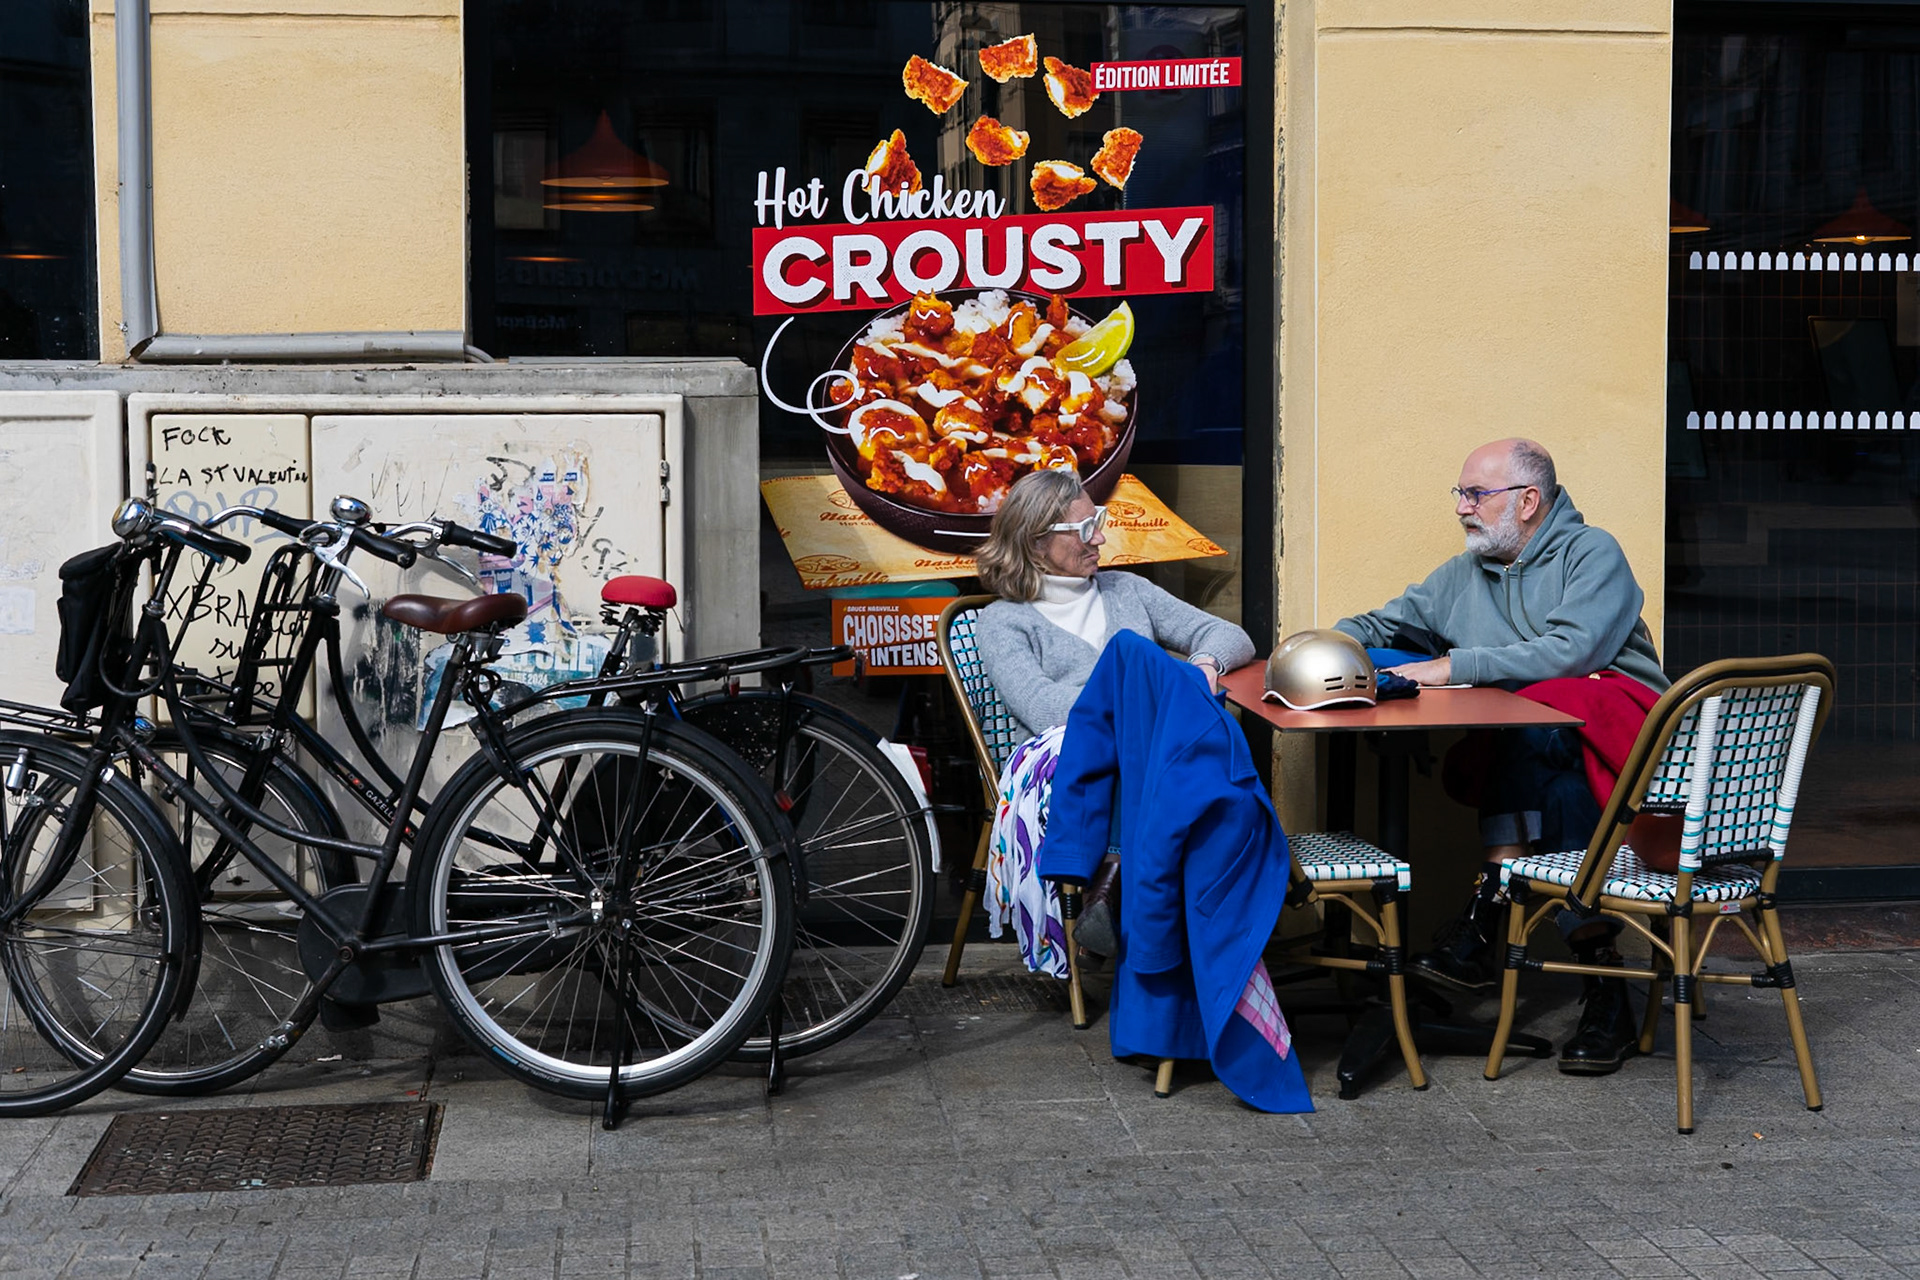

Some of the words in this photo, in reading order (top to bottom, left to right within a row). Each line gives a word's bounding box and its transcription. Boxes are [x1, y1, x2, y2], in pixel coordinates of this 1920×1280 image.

[1095, 64, 1160, 90] ÉDITION
[1165, 59, 1231, 87] LIMITÉE
[754, 167, 829, 230] Hot
[842, 168, 1006, 227] Chicken
[762, 217, 1204, 305] CROUSTY
[159, 467, 192, 487] LA
[803, 571, 890, 590] ashville
[871, 641, 943, 667] INTENS
[365, 789, 396, 820] GAZELL
